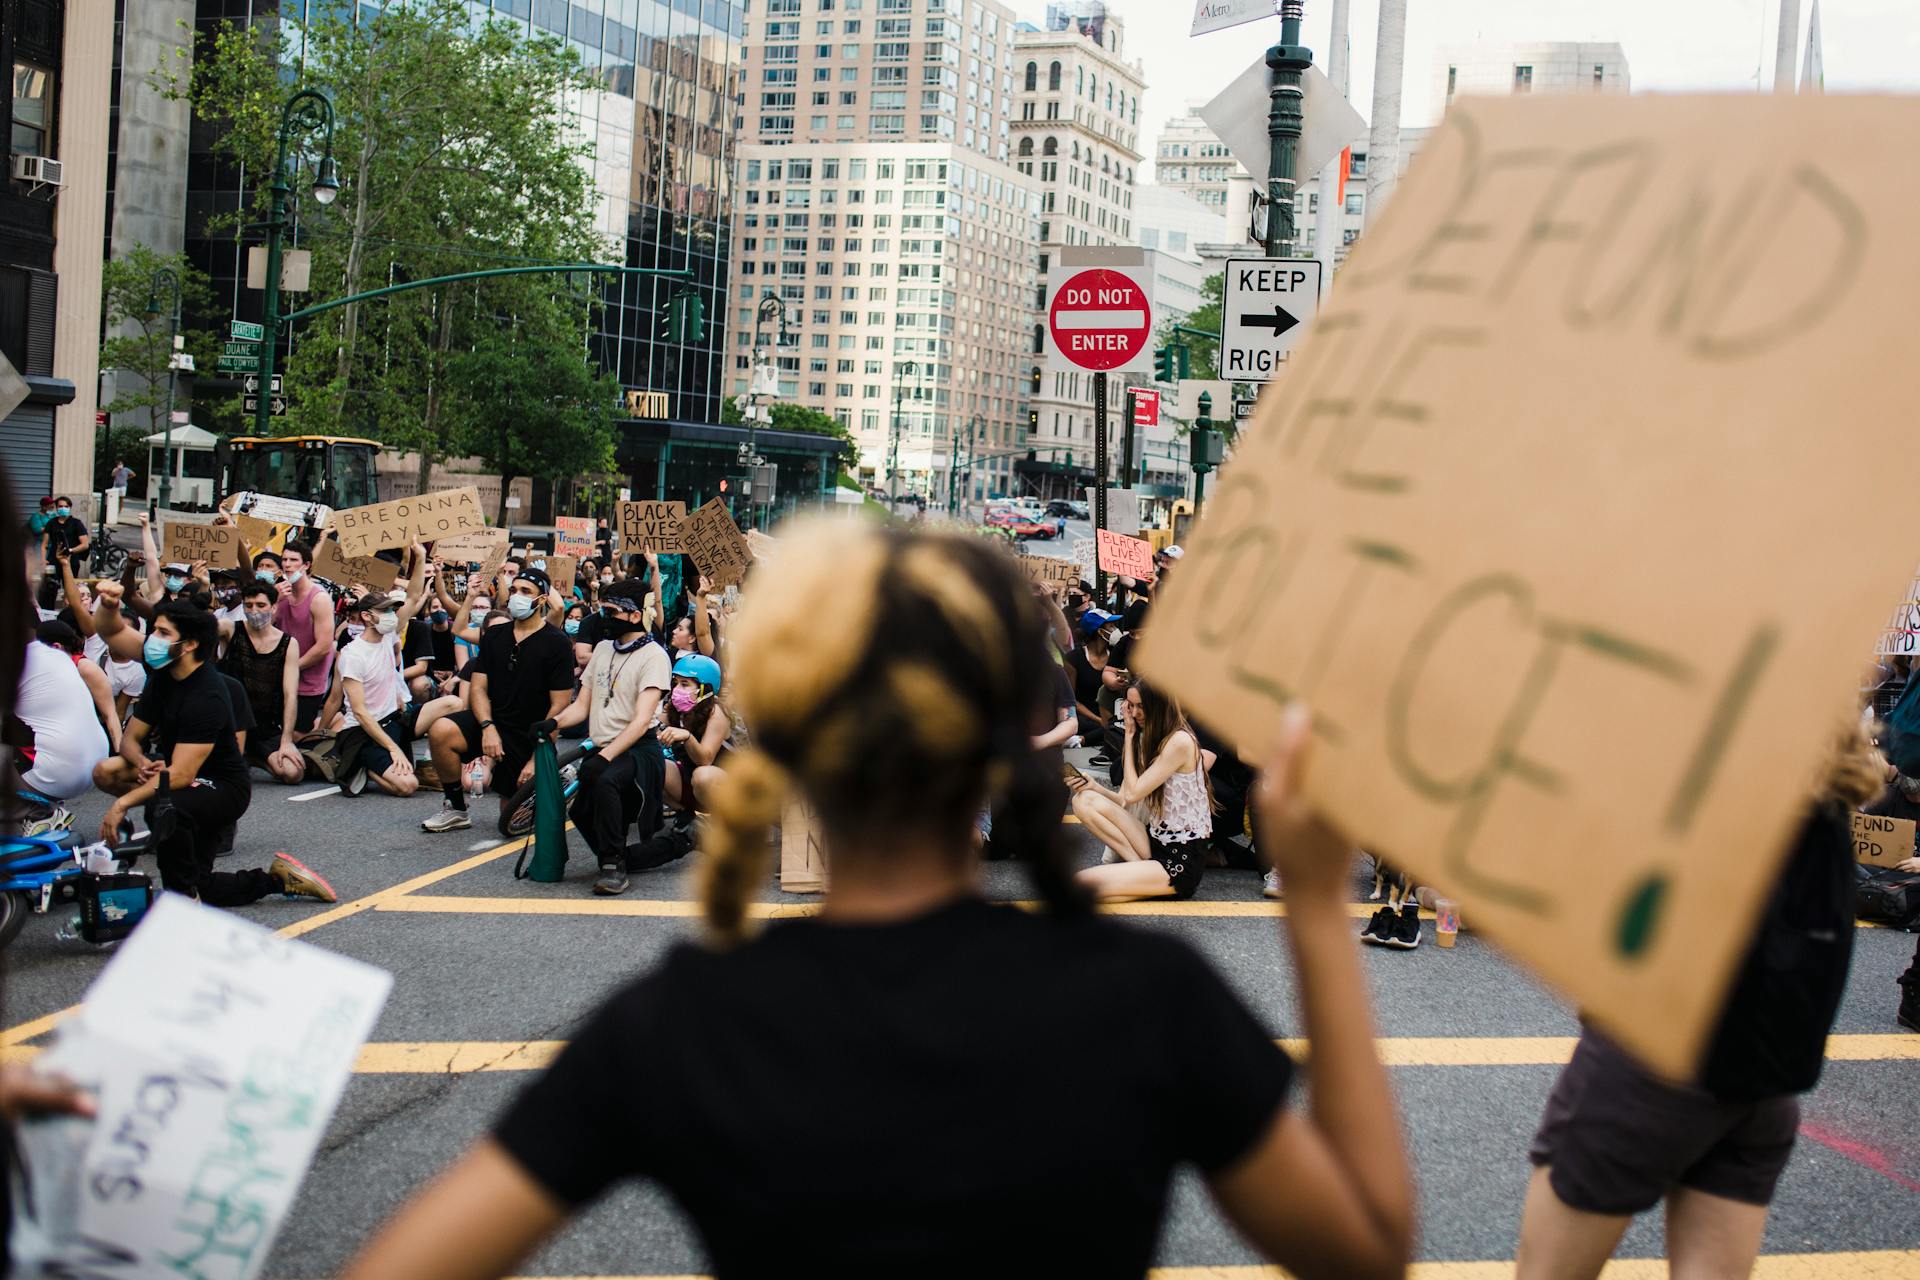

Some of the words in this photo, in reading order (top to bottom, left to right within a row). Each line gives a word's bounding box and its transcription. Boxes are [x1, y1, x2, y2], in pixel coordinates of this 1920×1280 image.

[1239, 269, 1306, 293] KEEP
[1067, 289, 1091, 305] DO
[1098, 288, 1132, 305] NOT
[225, 343, 251, 356] DUANE
[1071, 334, 1129, 351] ENTER
[1229, 349, 1290, 372] RIGH
[1240, 405, 1256, 414] ONE
[343, 493, 473, 528] BREONNA
[623, 503, 678, 521] BLACK
[711, 498, 738, 541] THERE
[358, 516, 472, 547] TAYLOR
[558, 518, 587, 529] Black
[623, 520, 678, 537] LIVES
[708, 516, 723, 543] TIME
[175, 525, 229, 544] DEFUND
[189, 539, 205, 548] THE
[557, 530, 591, 545] Trauma
[625, 536, 684, 551] MATTER
[1102, 532, 1142, 554] BLACK
[691, 517, 728, 571] SILENCE
[173, 545, 220, 563] POLICE
[1110, 545, 1142, 563] LIVES
[1103, 557, 1147, 577] MATTER
[1884, 631, 1915, 652] NYPD
[1853, 815, 1895, 832] FUND
[1849, 830, 1872, 841] THE
